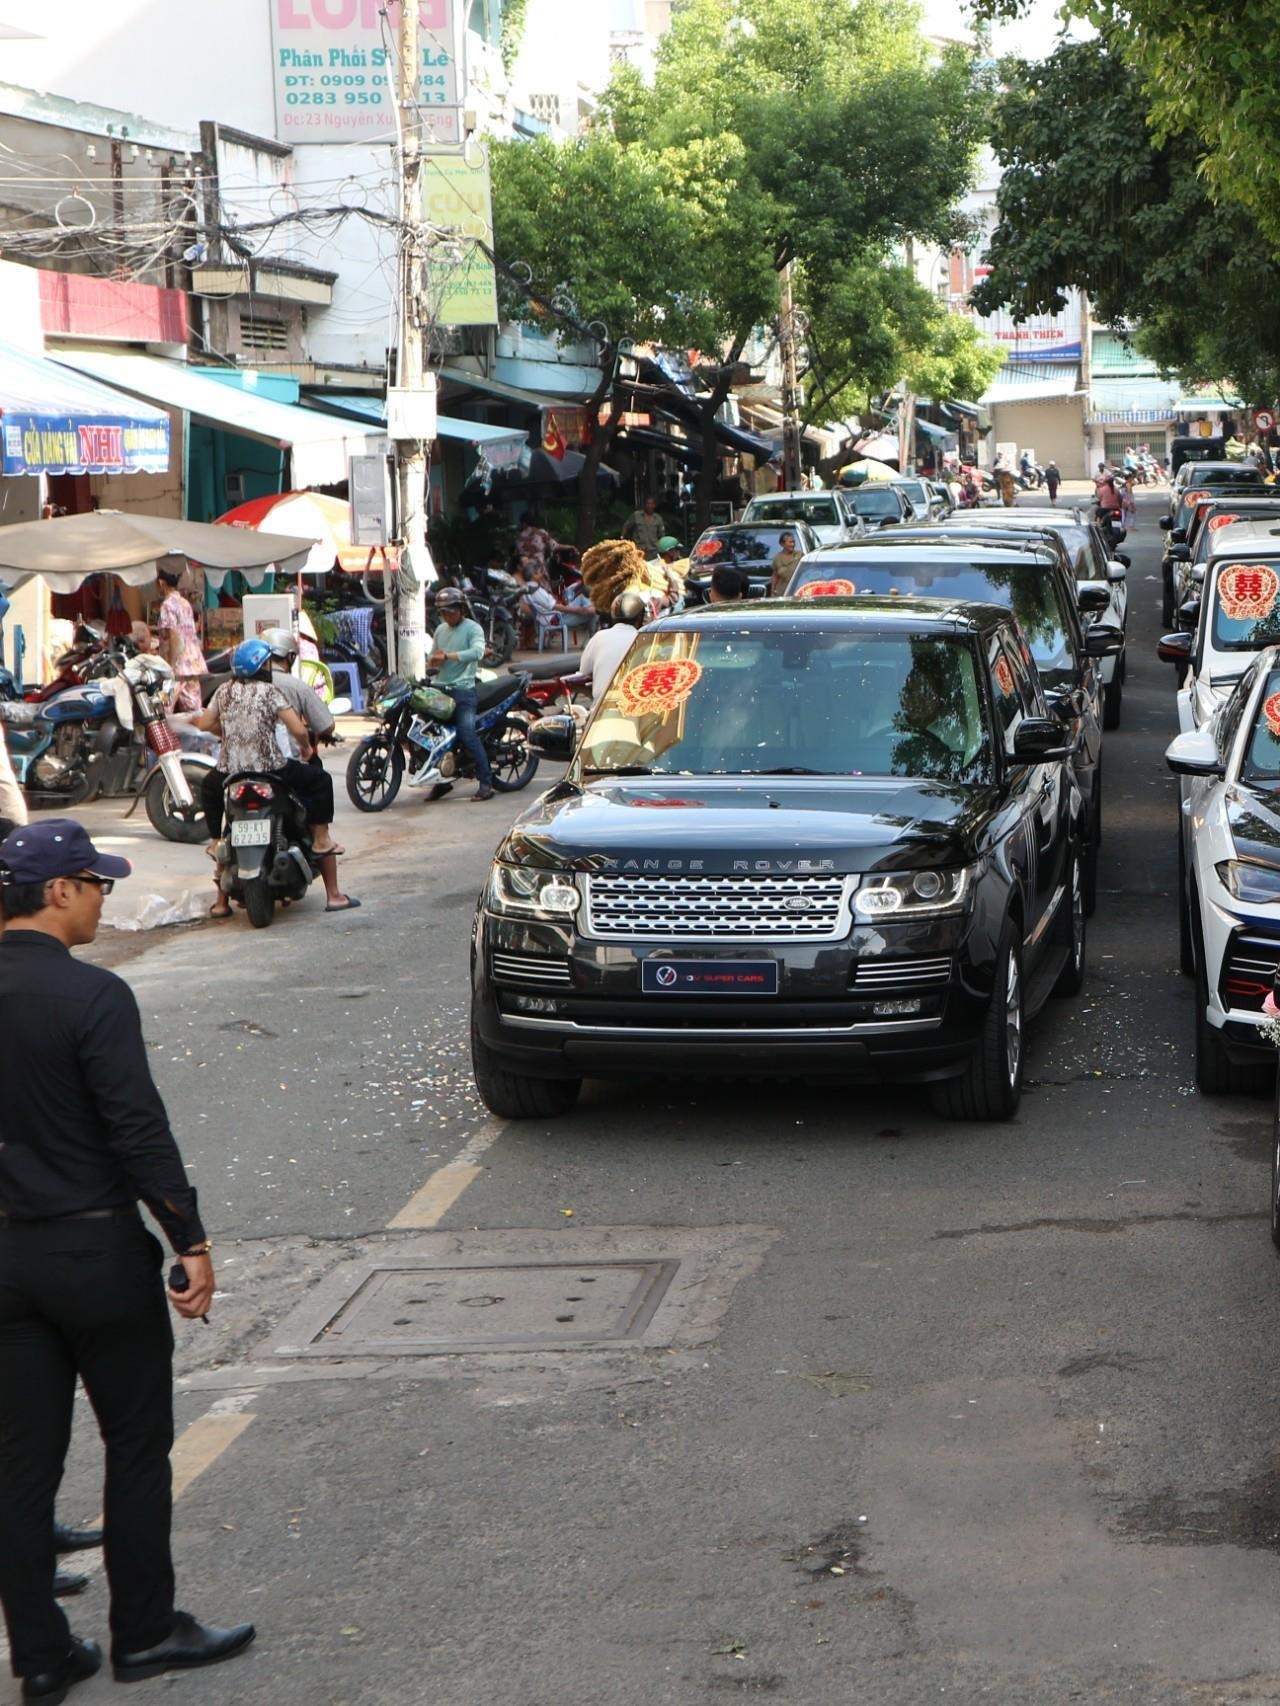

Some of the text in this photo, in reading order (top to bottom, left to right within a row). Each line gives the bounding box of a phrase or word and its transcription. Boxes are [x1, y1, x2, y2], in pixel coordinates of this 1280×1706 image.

[320, 75, 365, 86] 0909
[286, 92, 337, 105] 0283
[344, 92, 382, 105] 950
[78, 425, 123, 466] NHI
[603, 859, 835, 870] RANGE ROVER
